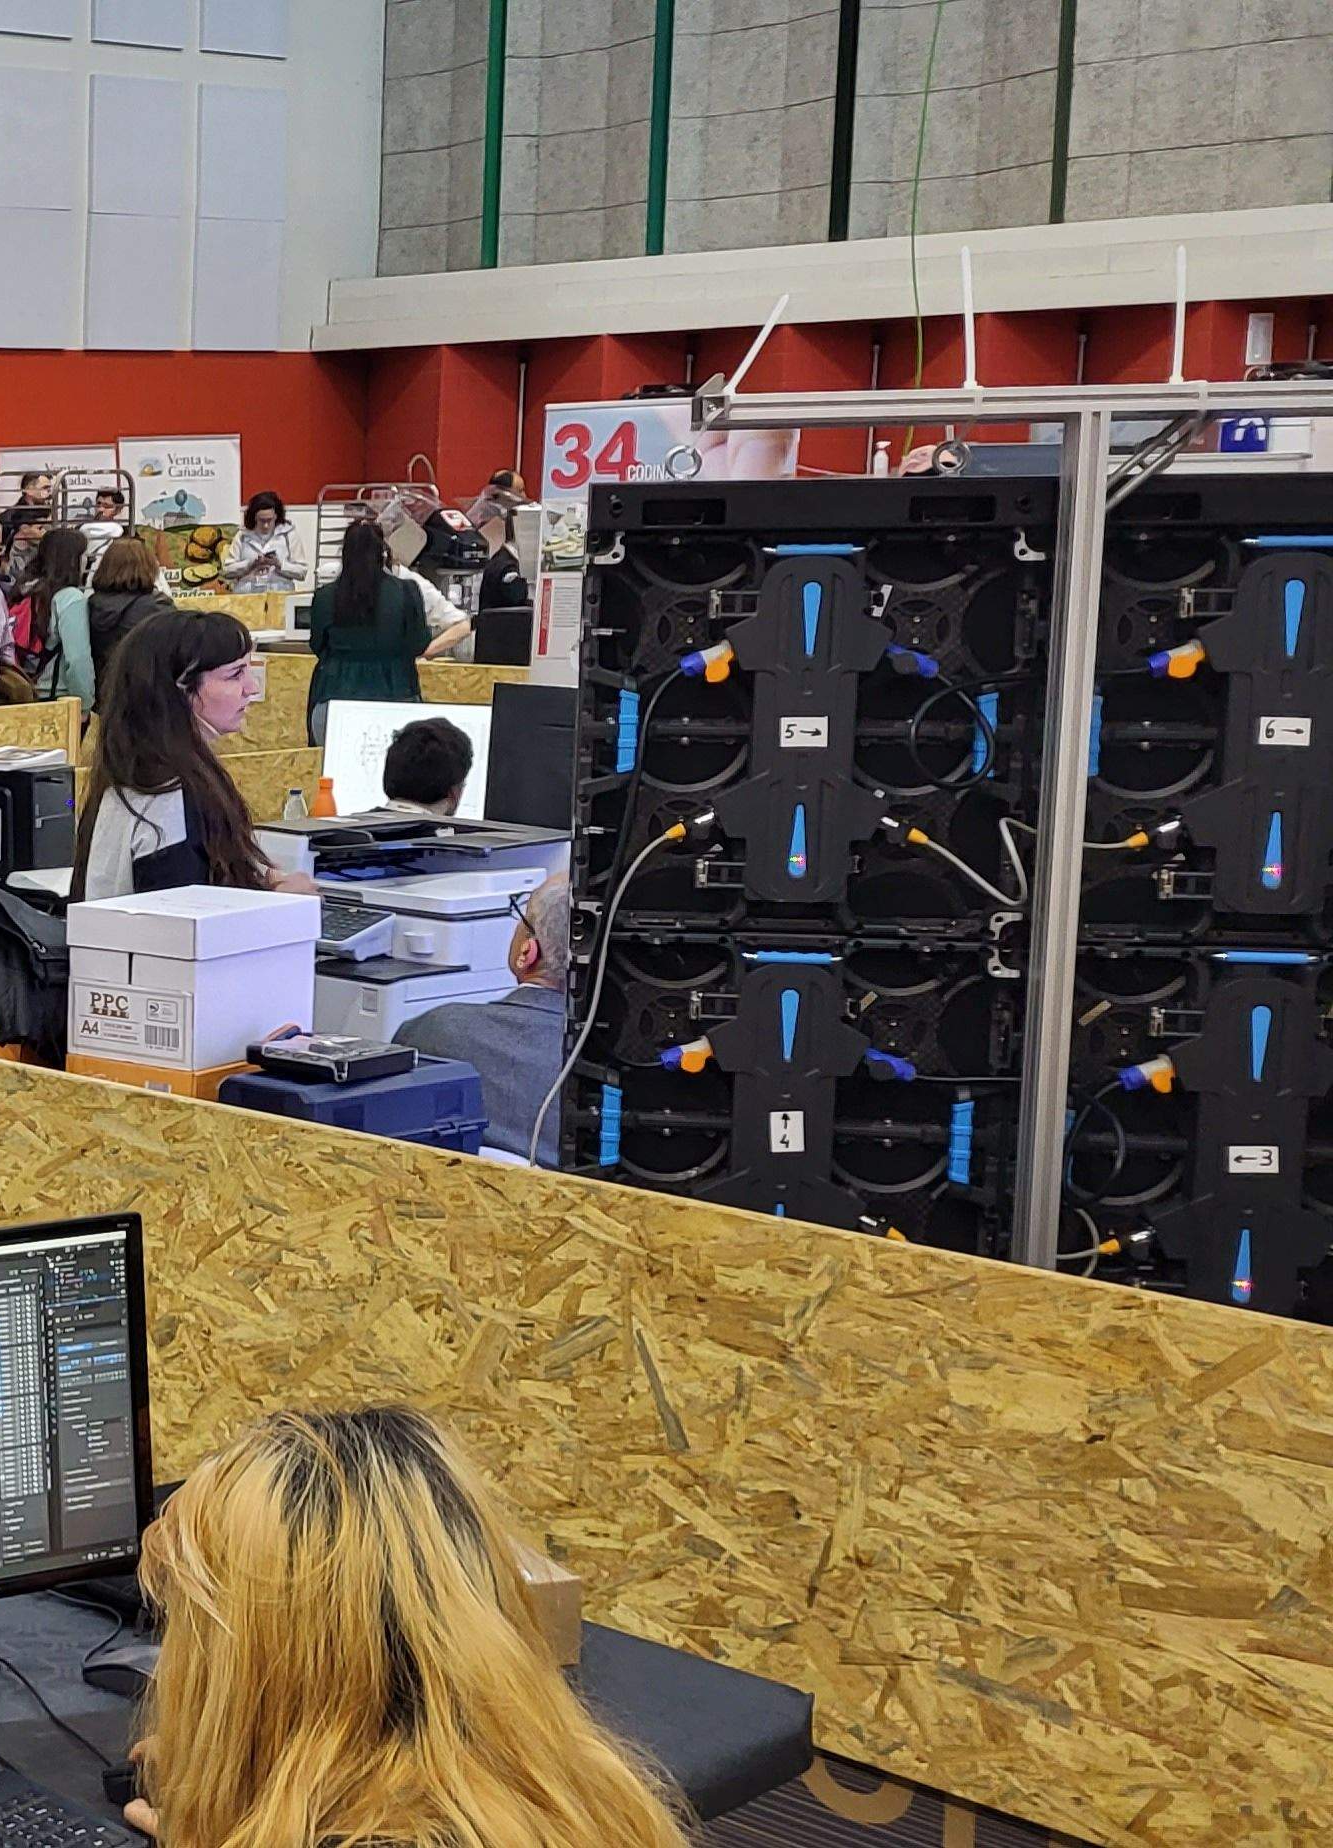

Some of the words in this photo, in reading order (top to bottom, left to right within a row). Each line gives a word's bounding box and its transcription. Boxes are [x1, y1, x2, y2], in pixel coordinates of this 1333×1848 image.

[167, 453, 201, 466] Venta
[550, 420, 643, 490] 34
[168, 465, 216, 477] Cañadas
[784, 723, 798, 739] 5
[1265, 719, 1276, 739] 6
[90, 991, 129, 1011] PPC
[80, 1019, 100, 1035] A4
[779, 1133, 790, 1149] 4
[1259, 1149, 1273, 1167] 3
